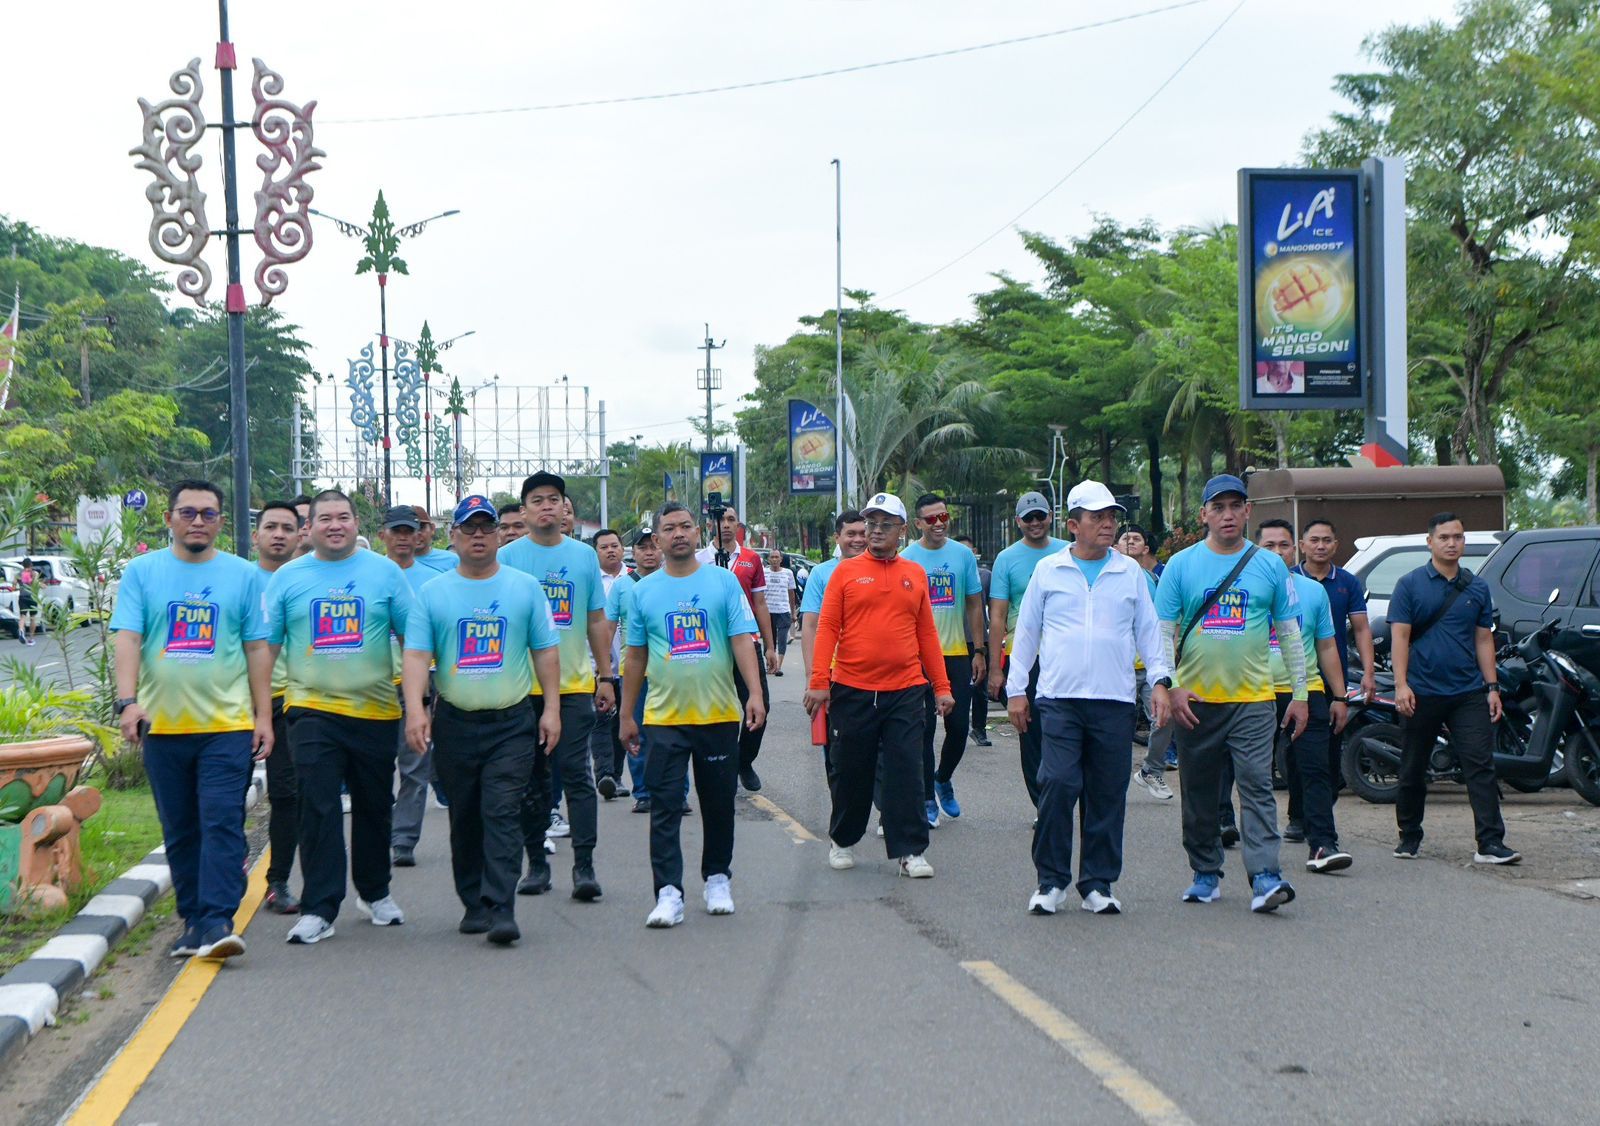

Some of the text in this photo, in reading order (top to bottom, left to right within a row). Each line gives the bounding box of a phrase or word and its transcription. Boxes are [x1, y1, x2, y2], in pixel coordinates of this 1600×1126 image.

[1313, 228, 1333, 236] ICE
[1279, 241, 1344, 253] MANGOBOOST
[1271, 324, 1293, 334] IT'S
[1262, 331, 1322, 347] MANGO
[1272, 339, 1349, 357] SEASON!
[930, 576, 951, 588] FUN
[1219, 593, 1241, 605] UN
[176, 606, 211, 623] FUN
[320, 602, 356, 618] FUN
[319, 616, 359, 635] RUN
[673, 614, 702, 629] FUN
[173, 621, 212, 640] RUN
[466, 622, 500, 638] FUN
[673, 627, 706, 642] RUN
[463, 636, 501, 654] RUN
